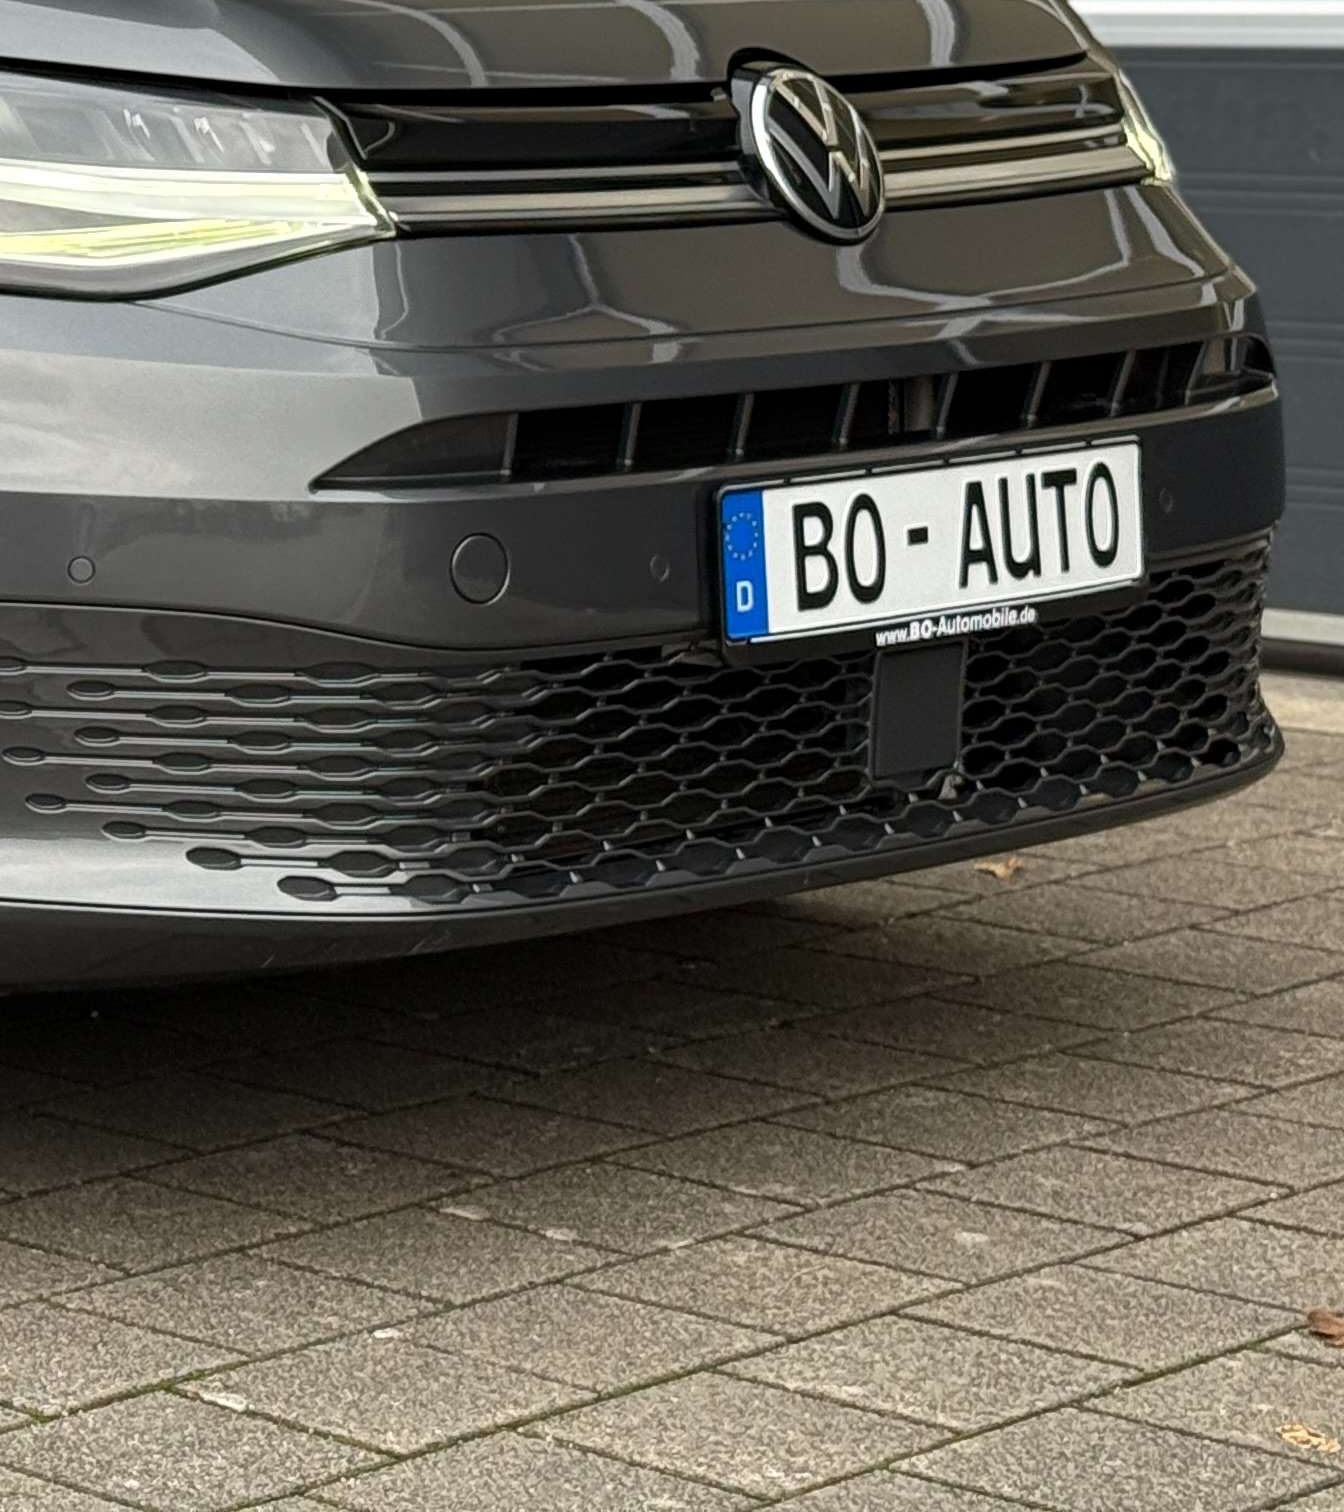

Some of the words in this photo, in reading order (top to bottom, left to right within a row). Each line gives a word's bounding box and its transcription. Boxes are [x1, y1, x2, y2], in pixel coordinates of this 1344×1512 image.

[792, 492, 886, 612] BO
[959, 462, 1119, 589] AUTO
[736, 581, 754, 612] D
[875, 605, 1038, 648] www.BO-Automobile.de
